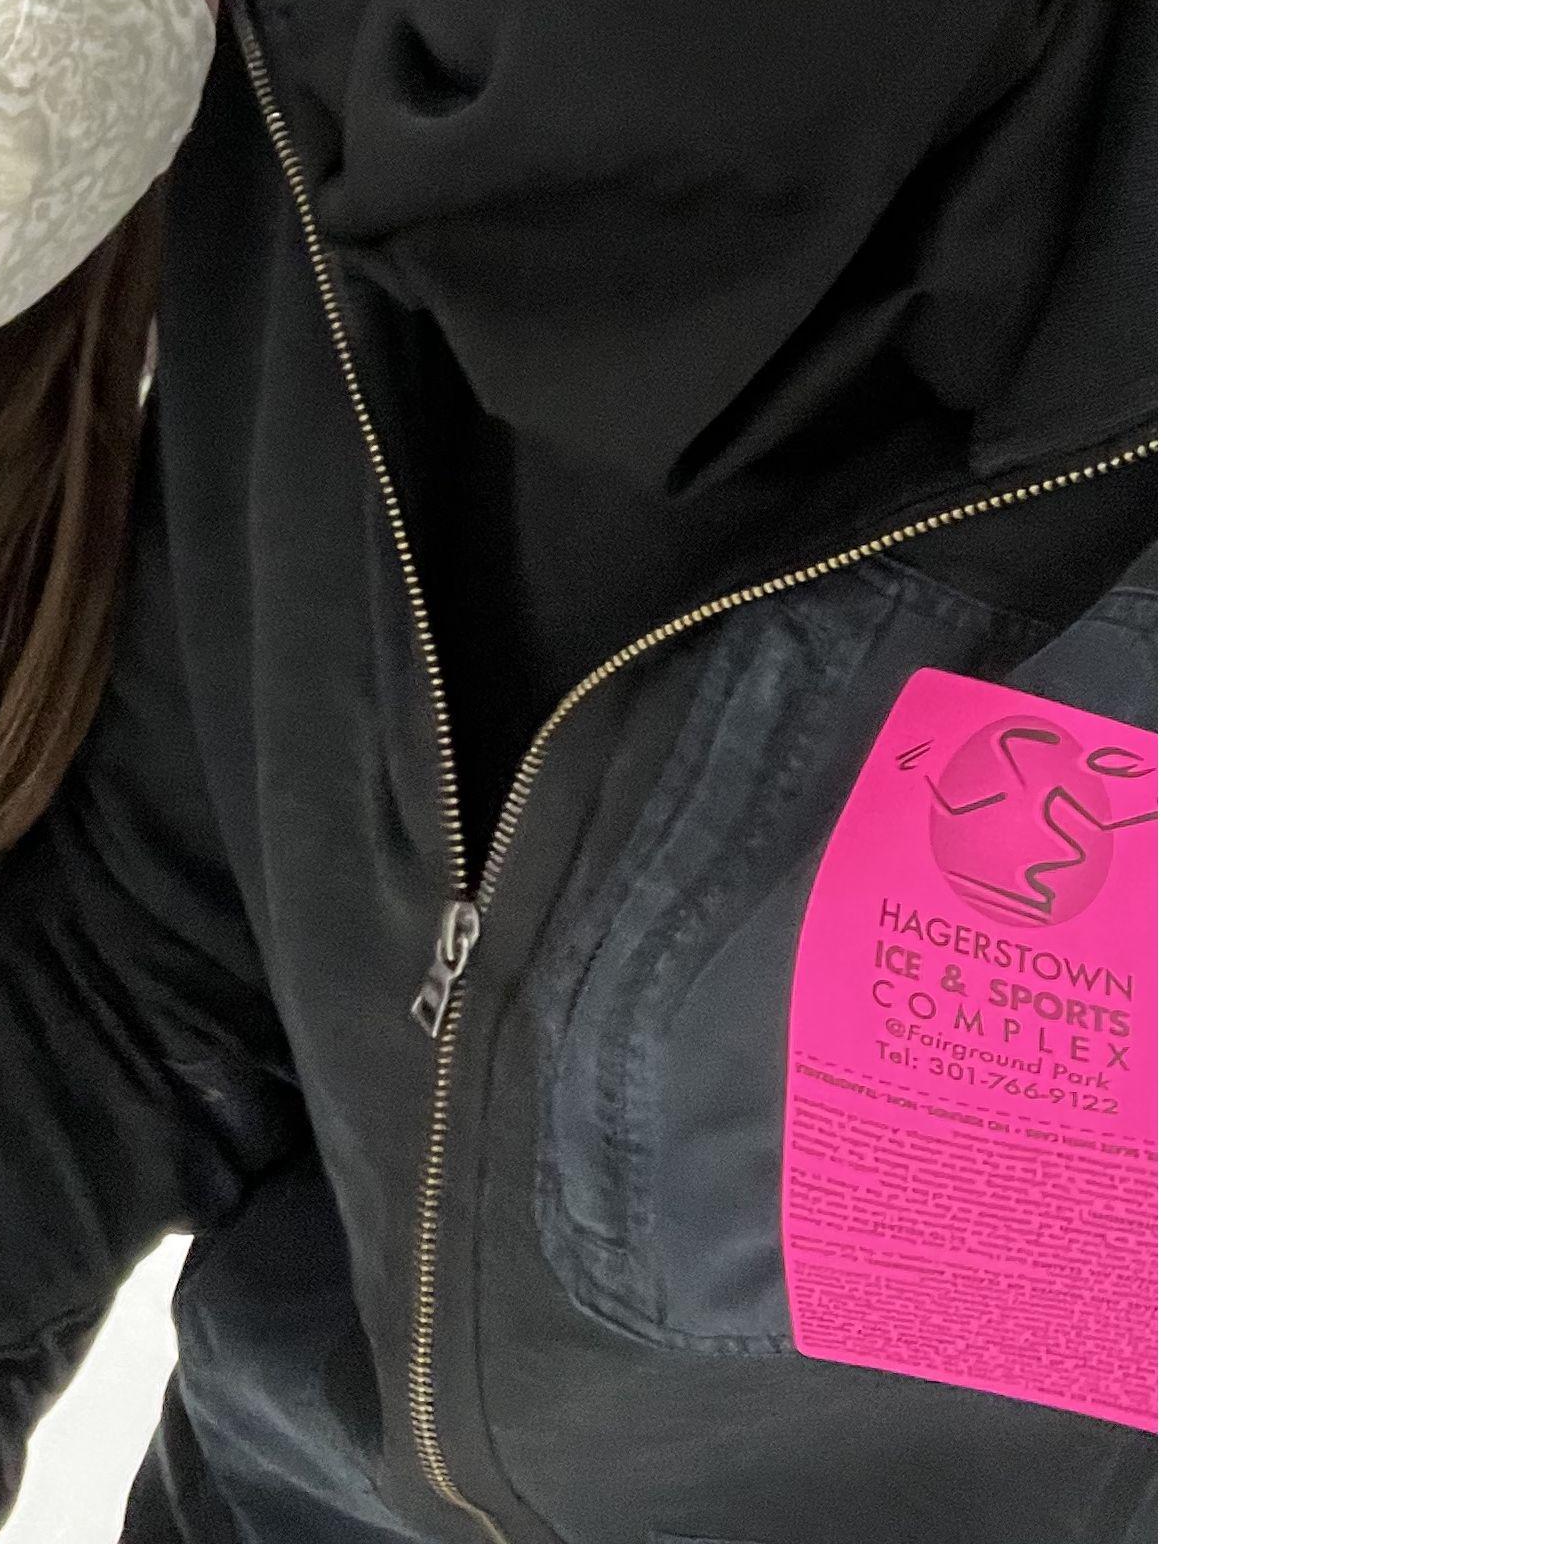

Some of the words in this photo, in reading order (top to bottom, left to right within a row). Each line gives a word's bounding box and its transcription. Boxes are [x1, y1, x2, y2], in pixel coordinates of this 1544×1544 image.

[874, 939, 922, 982] ICE
[939, 963, 969, 997] &
[988, 977, 1132, 1039] SPORTS
[878, 898, 1134, 1003] HAGERSTOWN
[871, 979, 1132, 1072] COMPLEX
[884, 1016, 1043, 1077] @Fairground
[1052, 1062, 1112, 1092] Park
[875, 1039, 918, 1071] Tel:
[928, 1055, 1121, 1117] 301-766-9122
